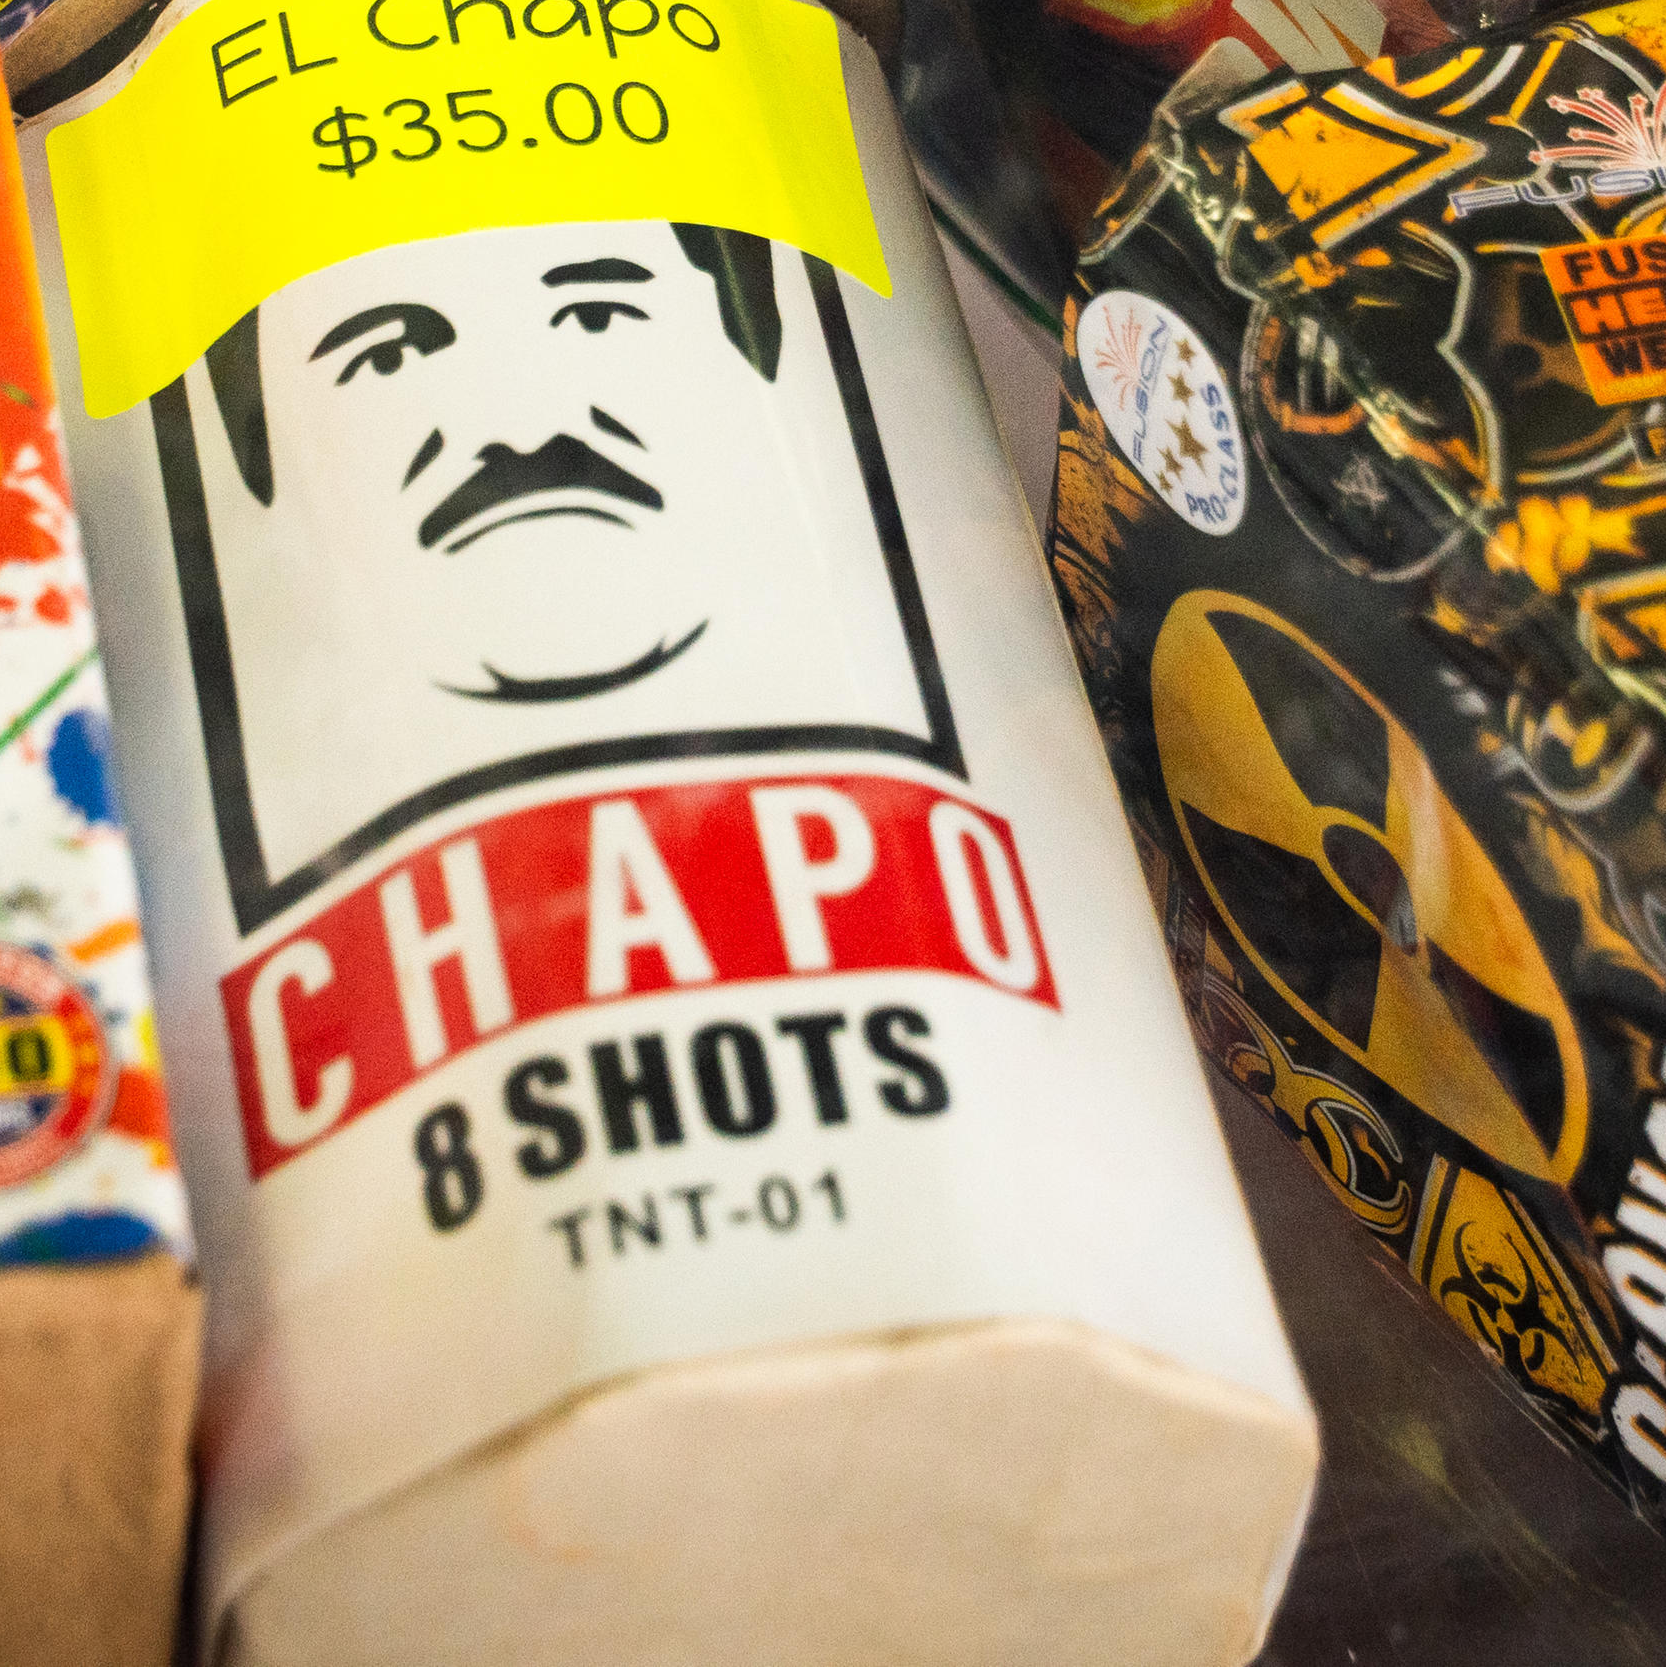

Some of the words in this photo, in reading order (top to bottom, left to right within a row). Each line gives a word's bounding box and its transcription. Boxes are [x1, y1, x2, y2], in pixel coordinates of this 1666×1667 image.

[208, 10, 339, 110] EL
[310, 80, 672, 180] $35.00
[1133, 314, 1168, 466] FUSION
[1184, 382, 1241, 526] PRO-CLASS
[245, 783, 1040, 1149] CHAPO
[414, 1101, 486, 1232] 8
[503, 1004, 950, 1180] SHOTS
[547, 1170, 849, 1271] TNT-01
